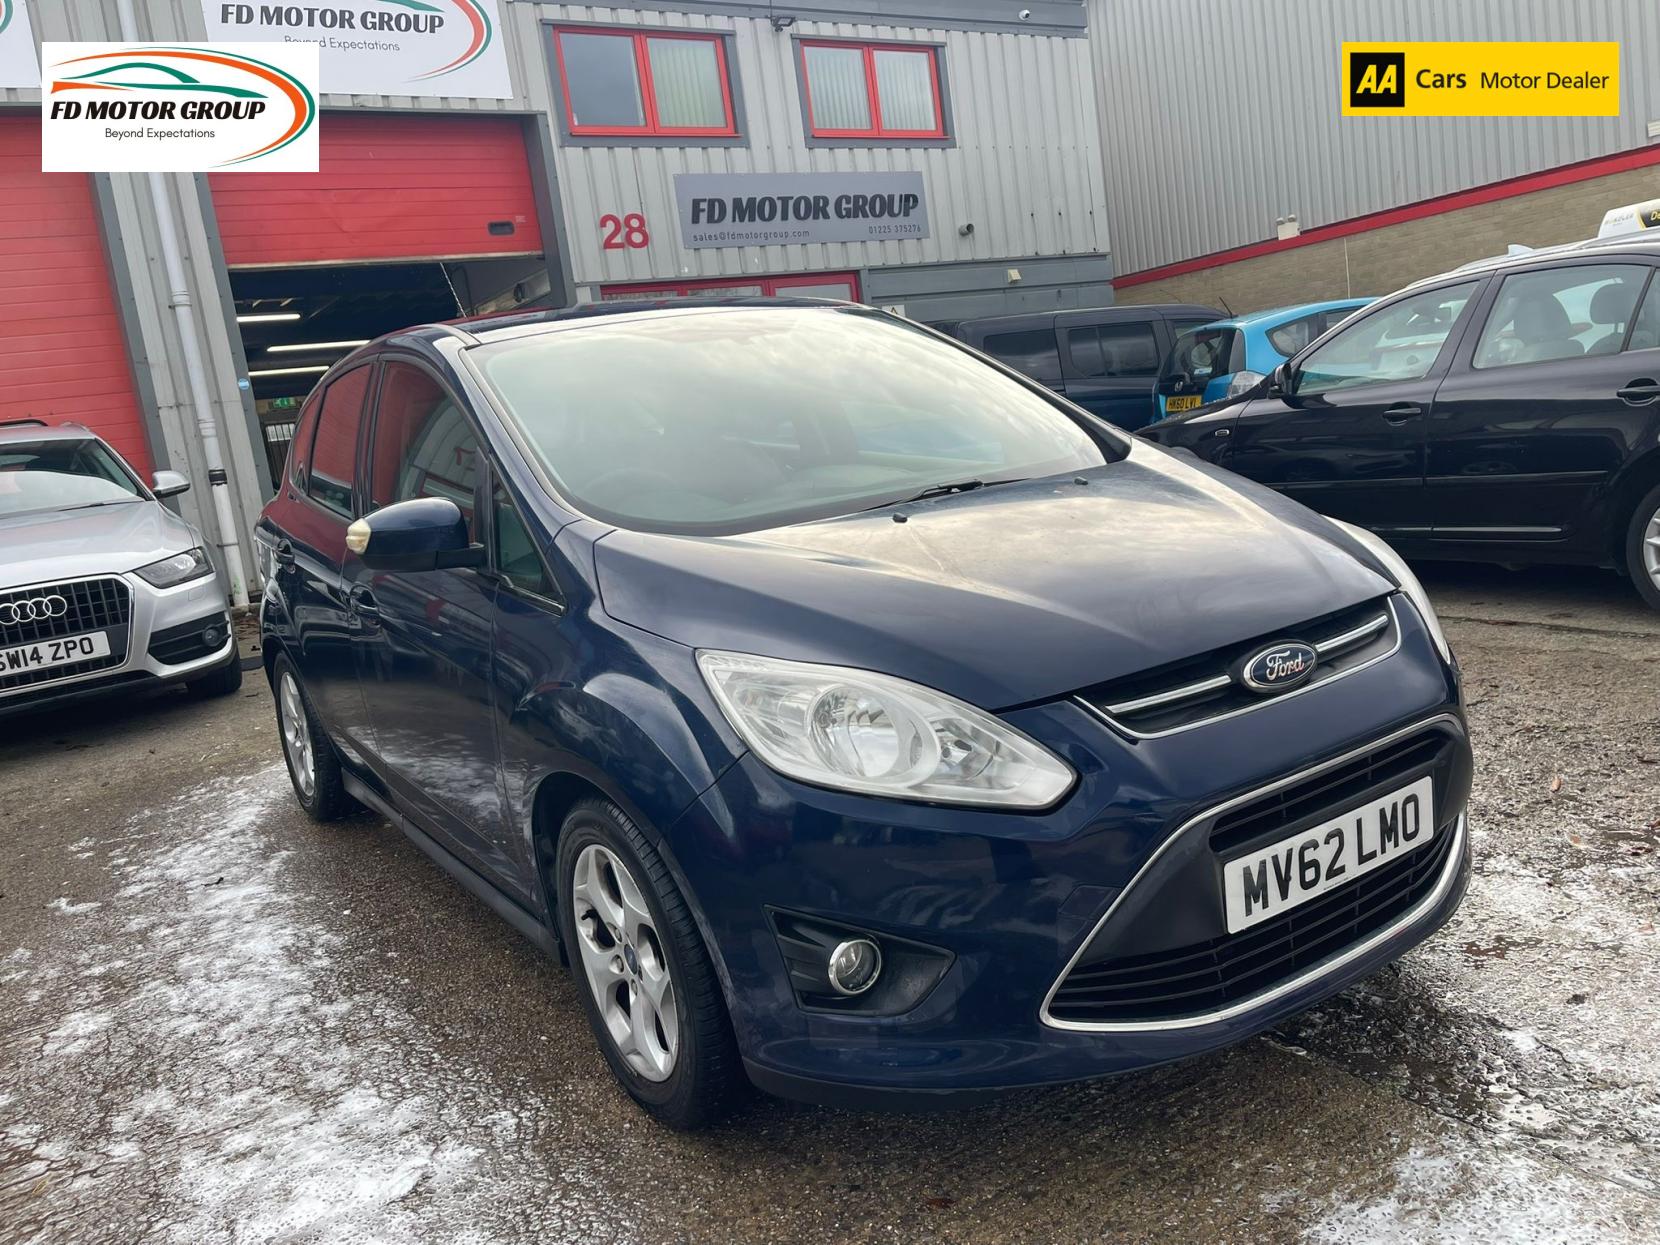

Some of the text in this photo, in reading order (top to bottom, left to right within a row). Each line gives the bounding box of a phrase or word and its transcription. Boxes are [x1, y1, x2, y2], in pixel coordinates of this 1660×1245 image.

[221, 4, 444, 34] FD MOTOR GROUP
[329, 37, 400, 52] Expectations
[691, 193, 919, 225] FD MOTOR GROUP
[599, 213, 650, 250] 28
[692, 229, 810, 242] sales@fdmotorgroup.com
[868, 225, 892, 235] 01225
[48, 637, 94, 661] ZPO
[1266, 650, 1305, 680] Ford
[1243, 793, 1420, 917] MV62 LMO
